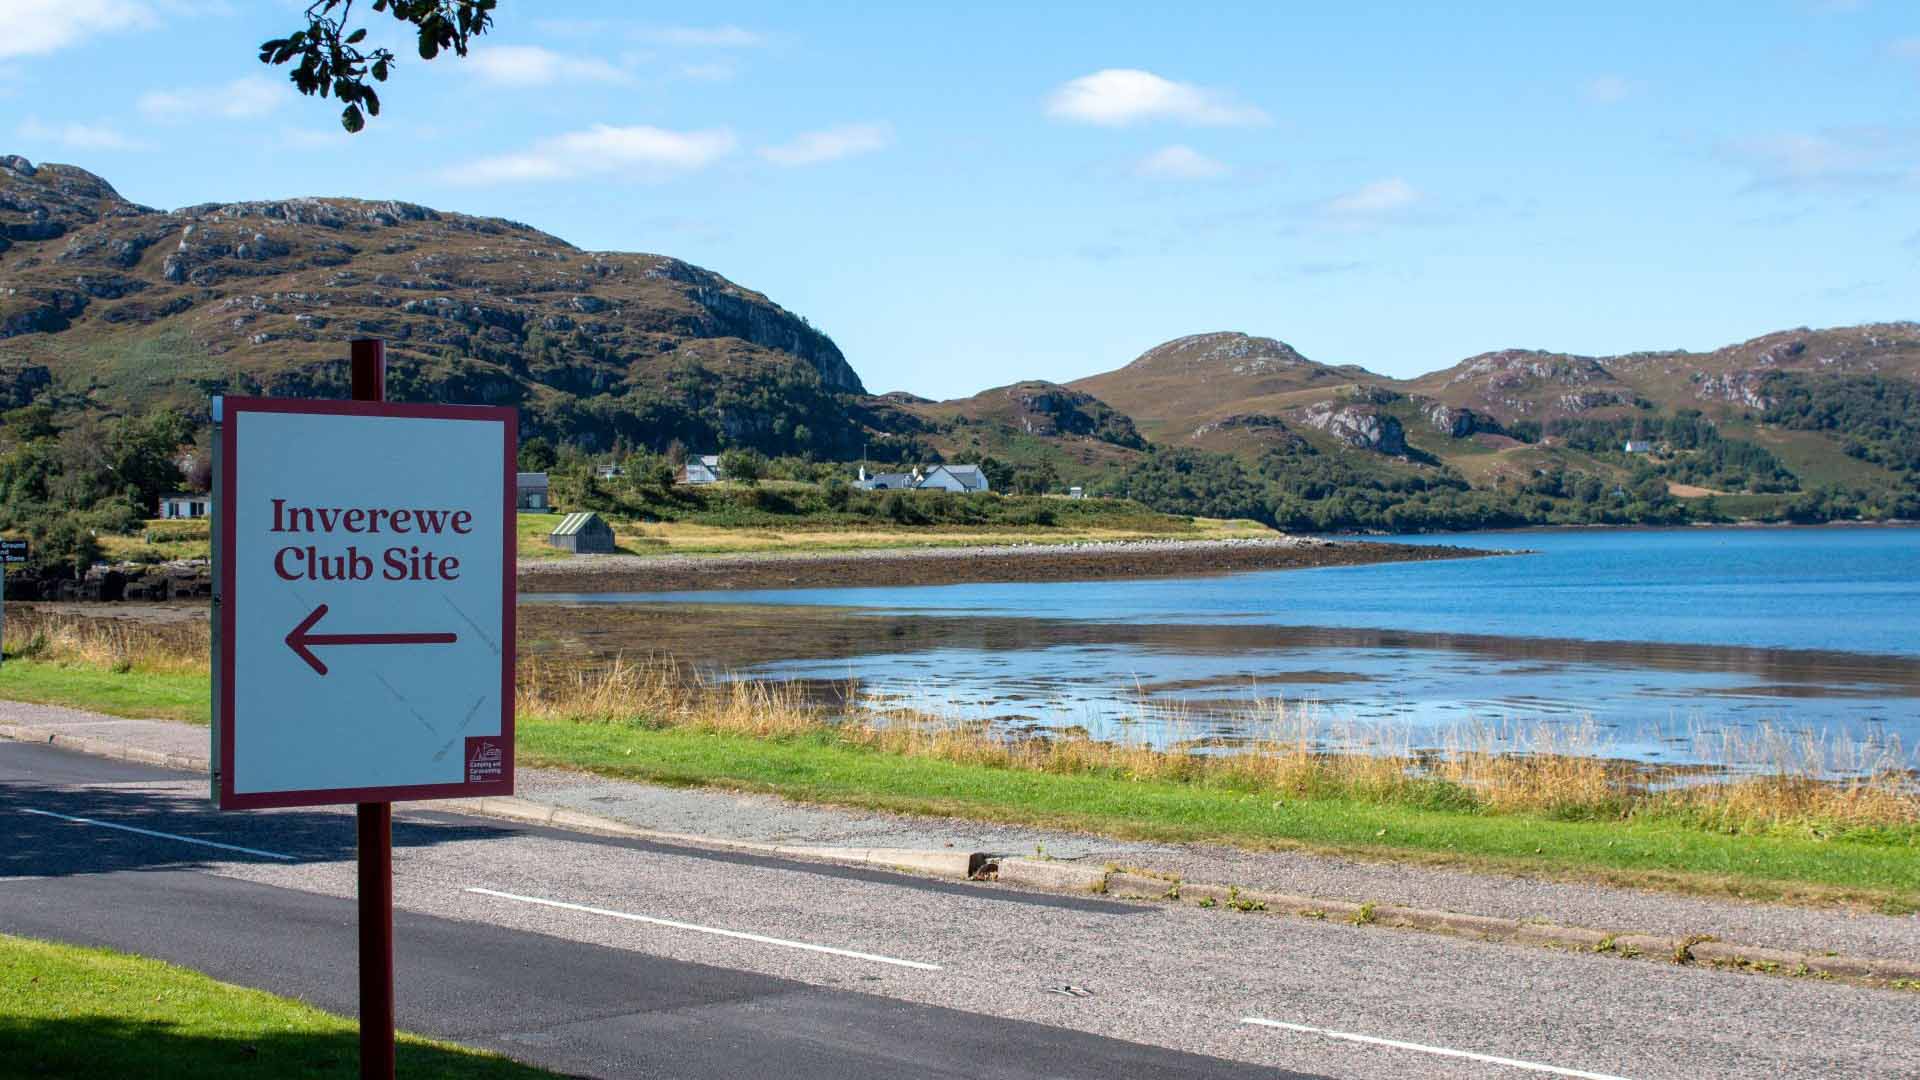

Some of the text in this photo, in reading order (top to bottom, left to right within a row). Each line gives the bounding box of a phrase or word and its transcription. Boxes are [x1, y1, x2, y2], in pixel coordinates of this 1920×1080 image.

[270, 498, 473, 534] Inverewe
[274, 545, 460, 581] Club Site
[470, 761, 492, 769] Camping
